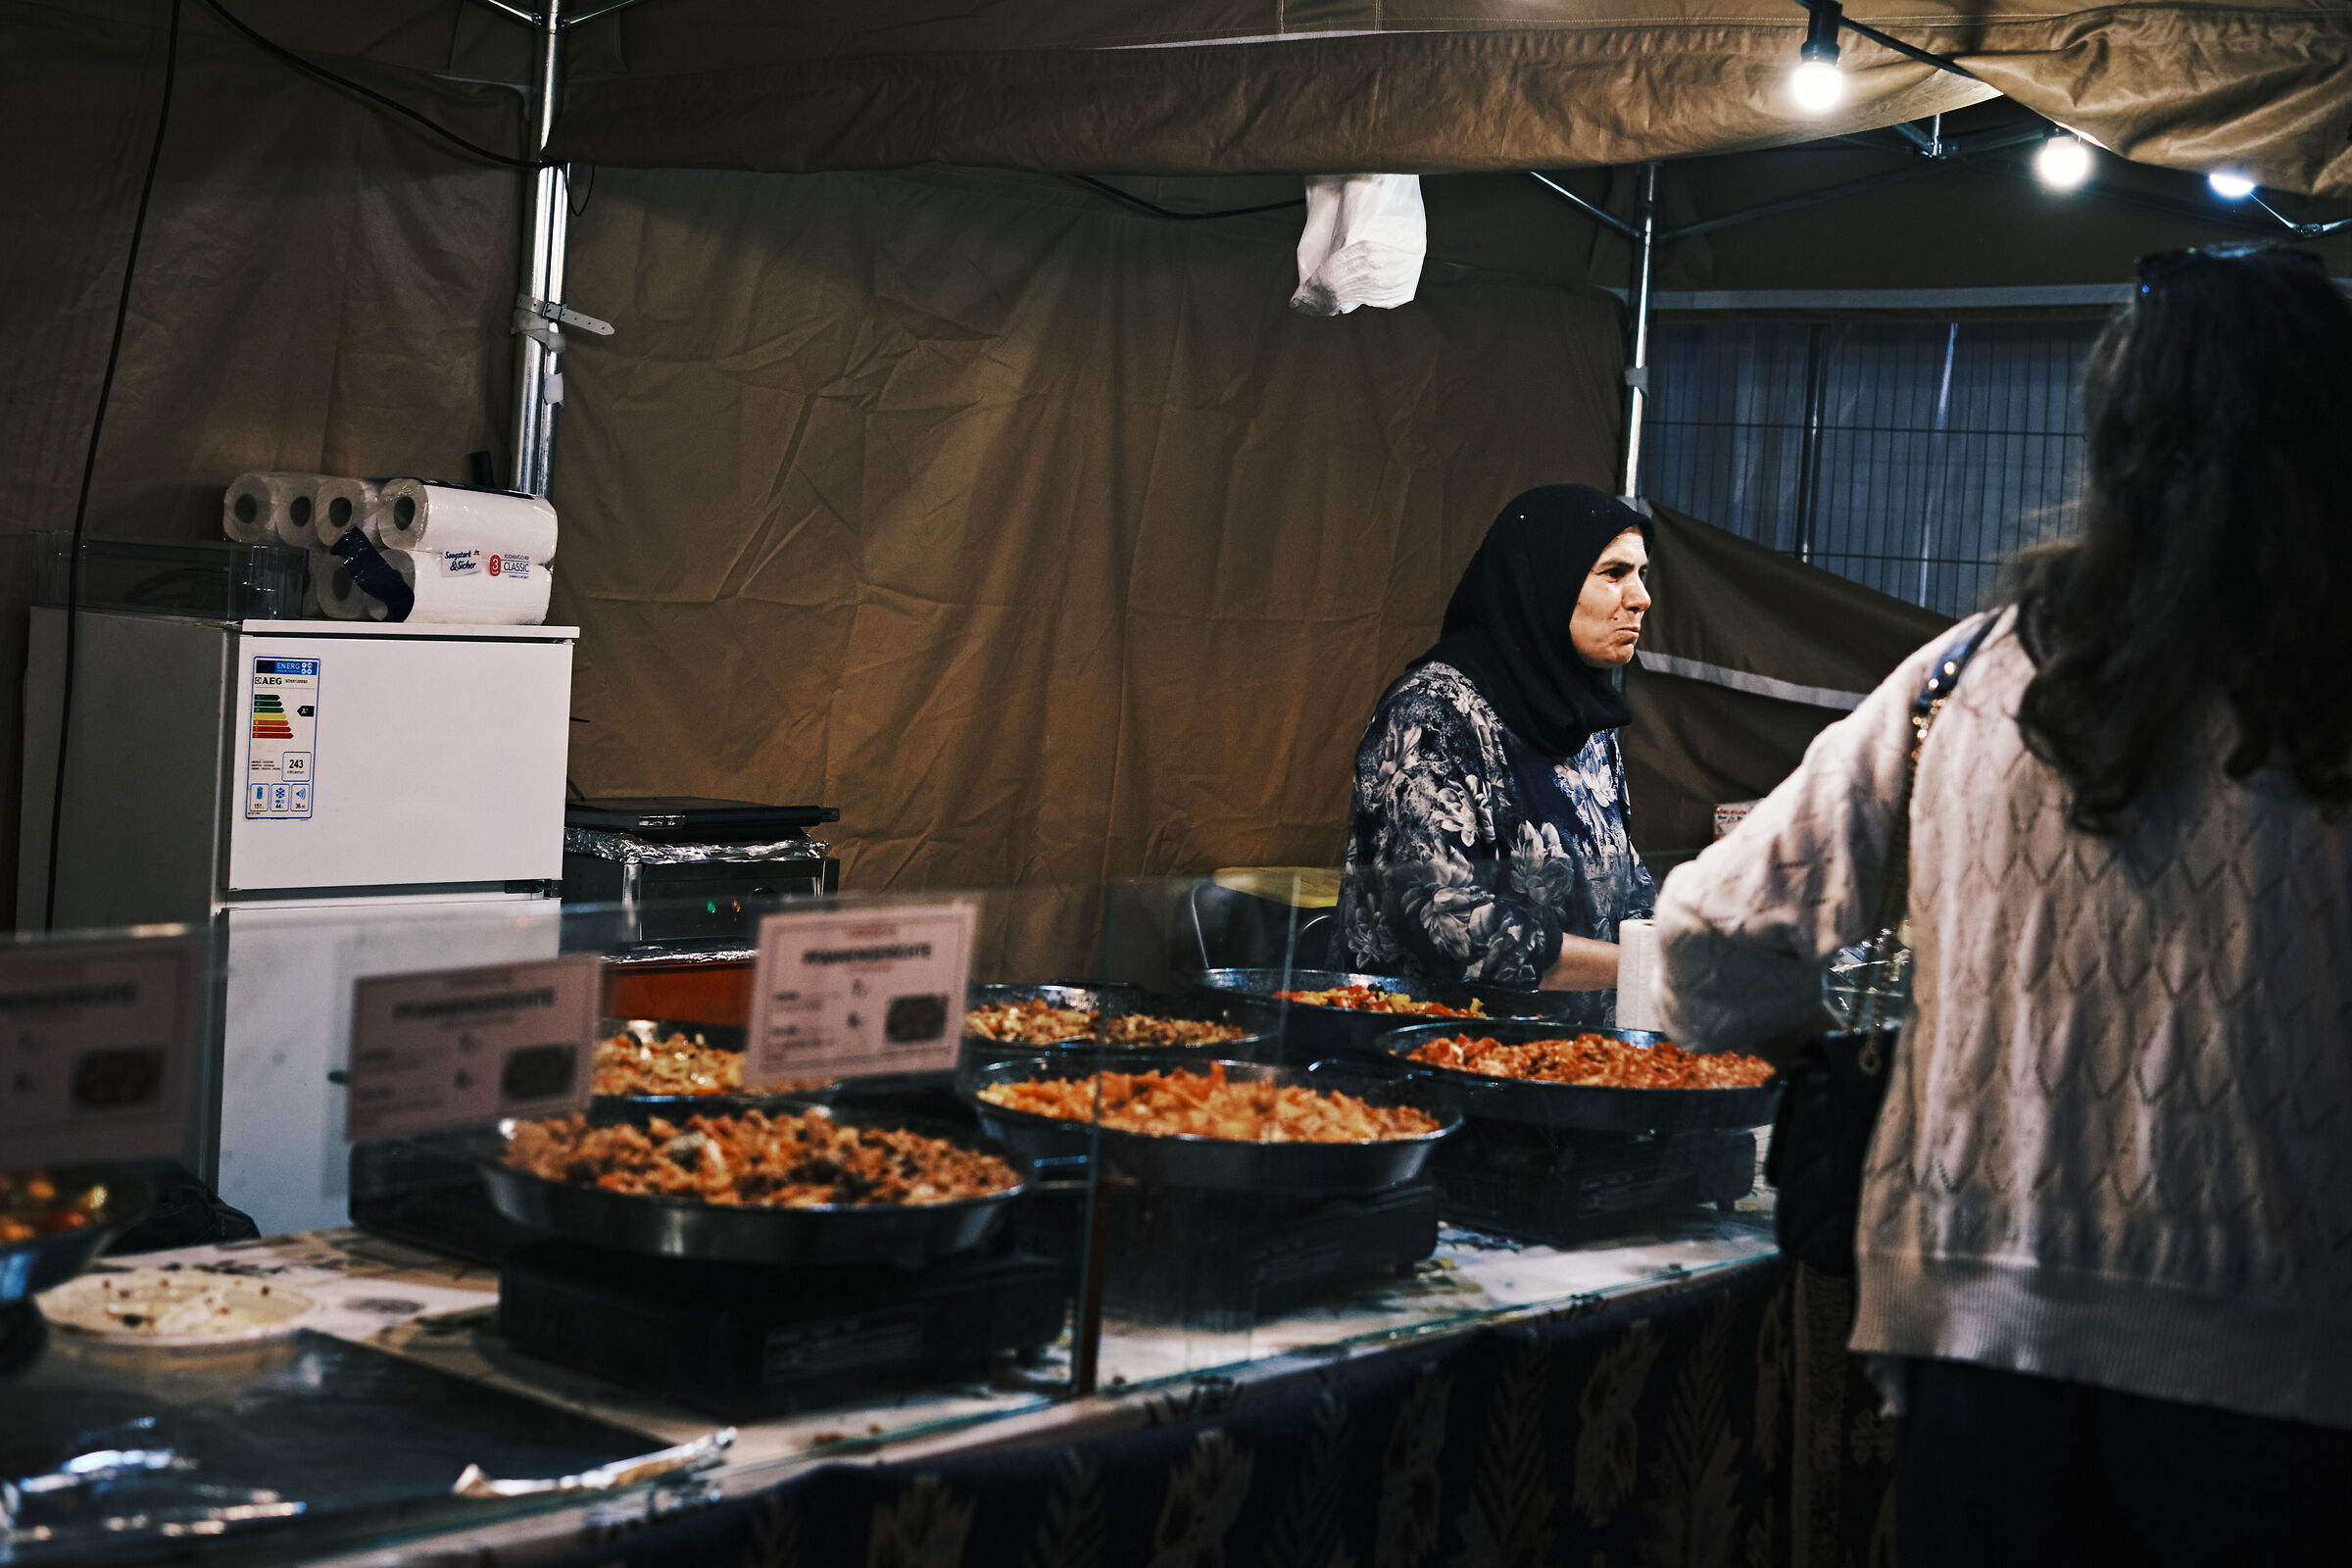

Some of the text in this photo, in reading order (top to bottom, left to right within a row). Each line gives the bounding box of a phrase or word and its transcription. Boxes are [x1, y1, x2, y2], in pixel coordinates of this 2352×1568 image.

[492, 559, 499, 570] 3
[503, 562, 529, 573] CLASSIC
[276, 662, 301, 670] ENERG
[262, 676, 282, 685] AEG
[289, 759, 304, 769] 243
